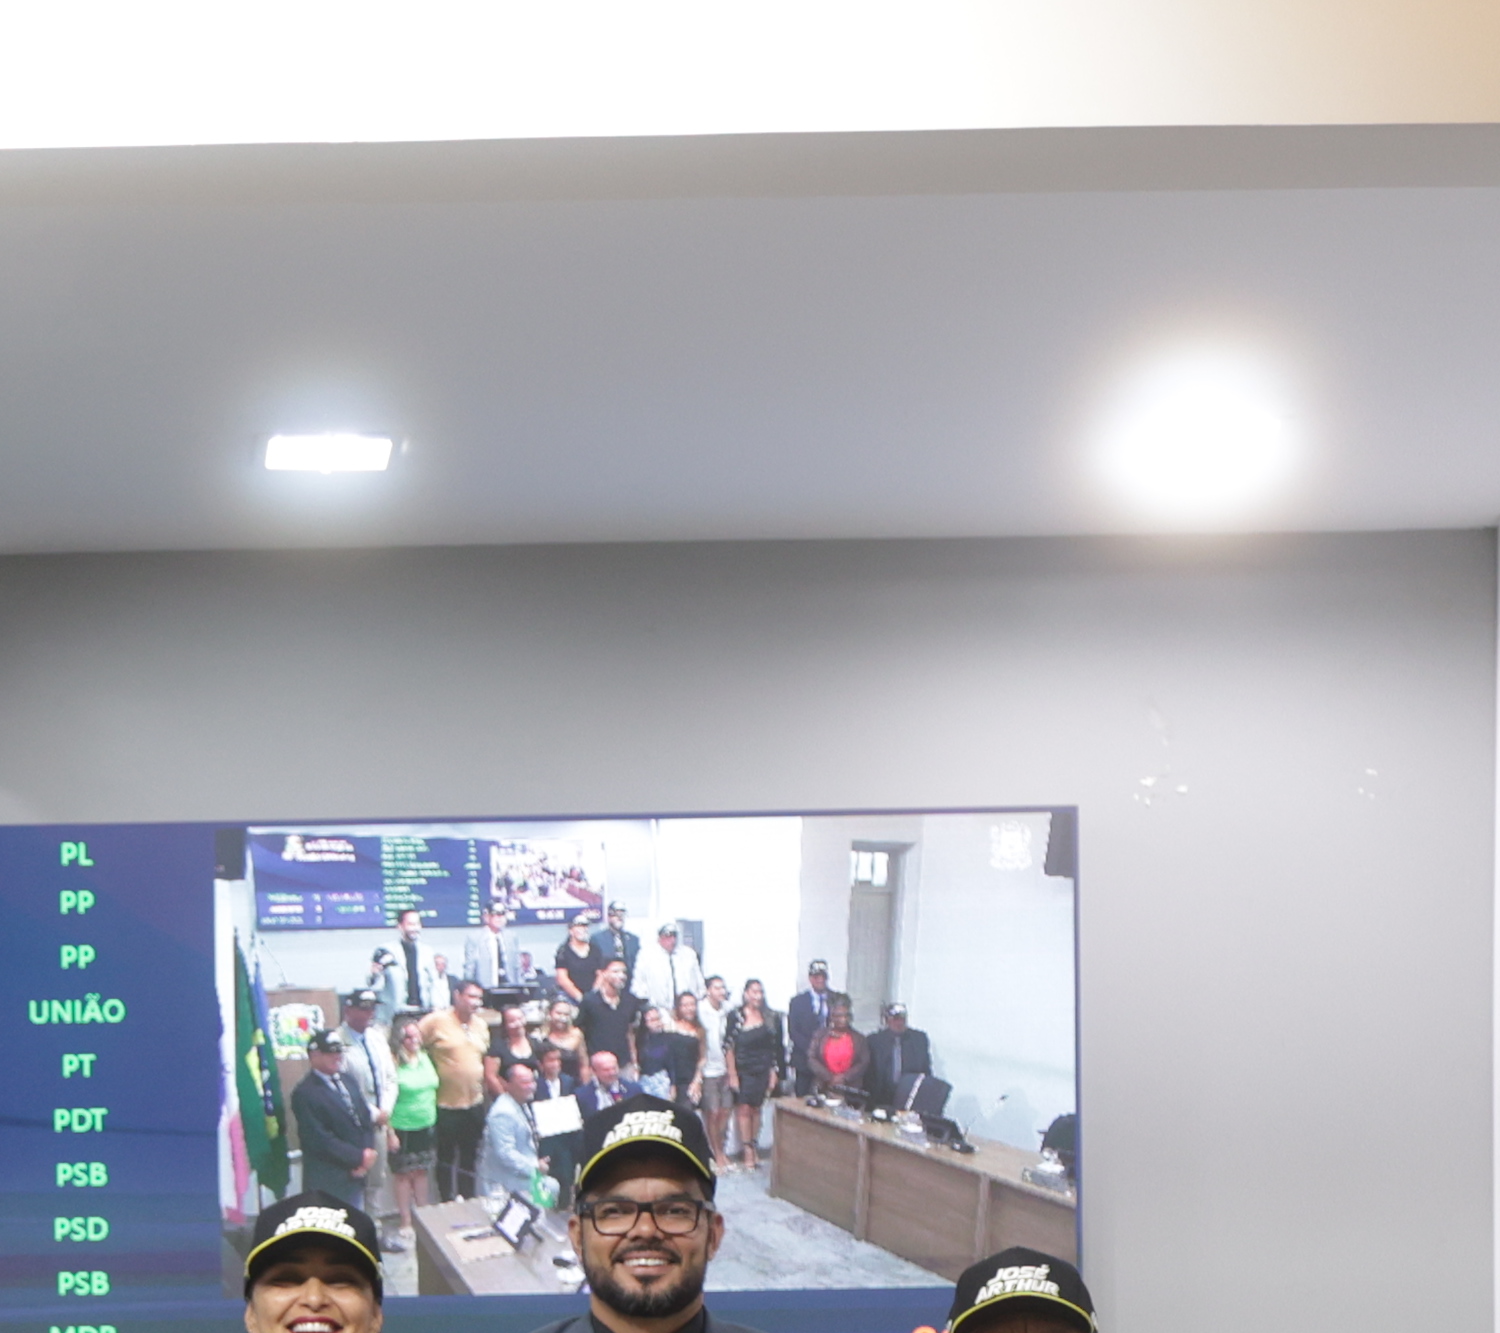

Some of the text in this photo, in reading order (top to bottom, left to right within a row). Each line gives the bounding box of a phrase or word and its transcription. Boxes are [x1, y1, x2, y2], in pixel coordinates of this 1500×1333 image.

[59, 841, 95, 867] PL
[59, 889, 96, 915] PP
[60, 943, 97, 969] PP
[28, 992, 127, 1025] UNIÃO
[62, 1053, 98, 1078] PT
[53, 1107, 109, 1133] PDT
[614, 1110, 674, 1130] JOSÉ
[602, 1123, 682, 1148] ARTHUR
[55, 1161, 109, 1188] PSB
[285, 1206, 348, 1224] JOSÉ
[53, 1215, 111, 1243] PSD
[56, 1270, 111, 1297] PSB
[986, 1264, 1050, 1285] JOSÉ
[974, 1279, 1060, 1305] ARTHUR
